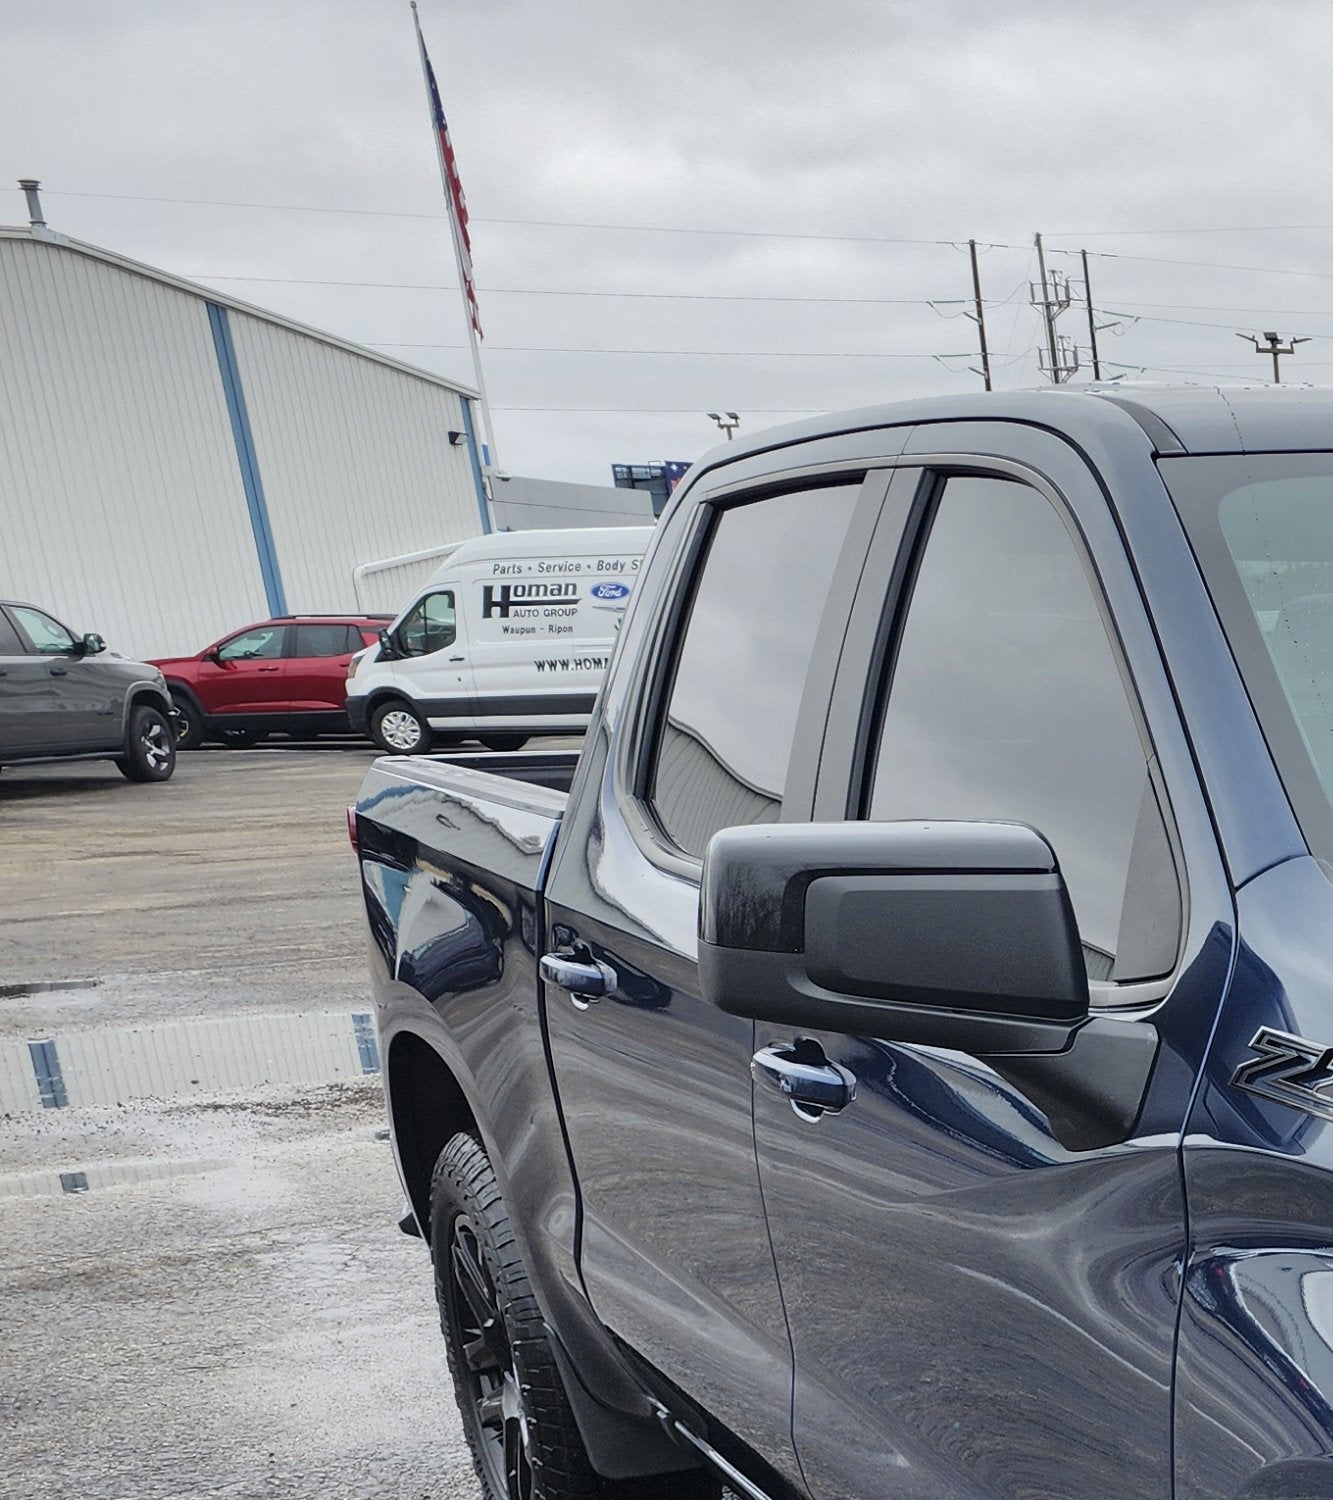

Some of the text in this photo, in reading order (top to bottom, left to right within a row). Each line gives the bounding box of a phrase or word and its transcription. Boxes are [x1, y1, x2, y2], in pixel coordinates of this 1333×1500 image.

[493, 563, 522, 575] Parts
[538, 560, 581, 573] Service
[597, 559, 626, 573] Body
[597, 585, 623, 598] Ford
[482, 583, 578, 619] Homan
[513, 607, 578, 618] AUTO GROUP
[502, 623, 573, 636] Waupun Ripon
